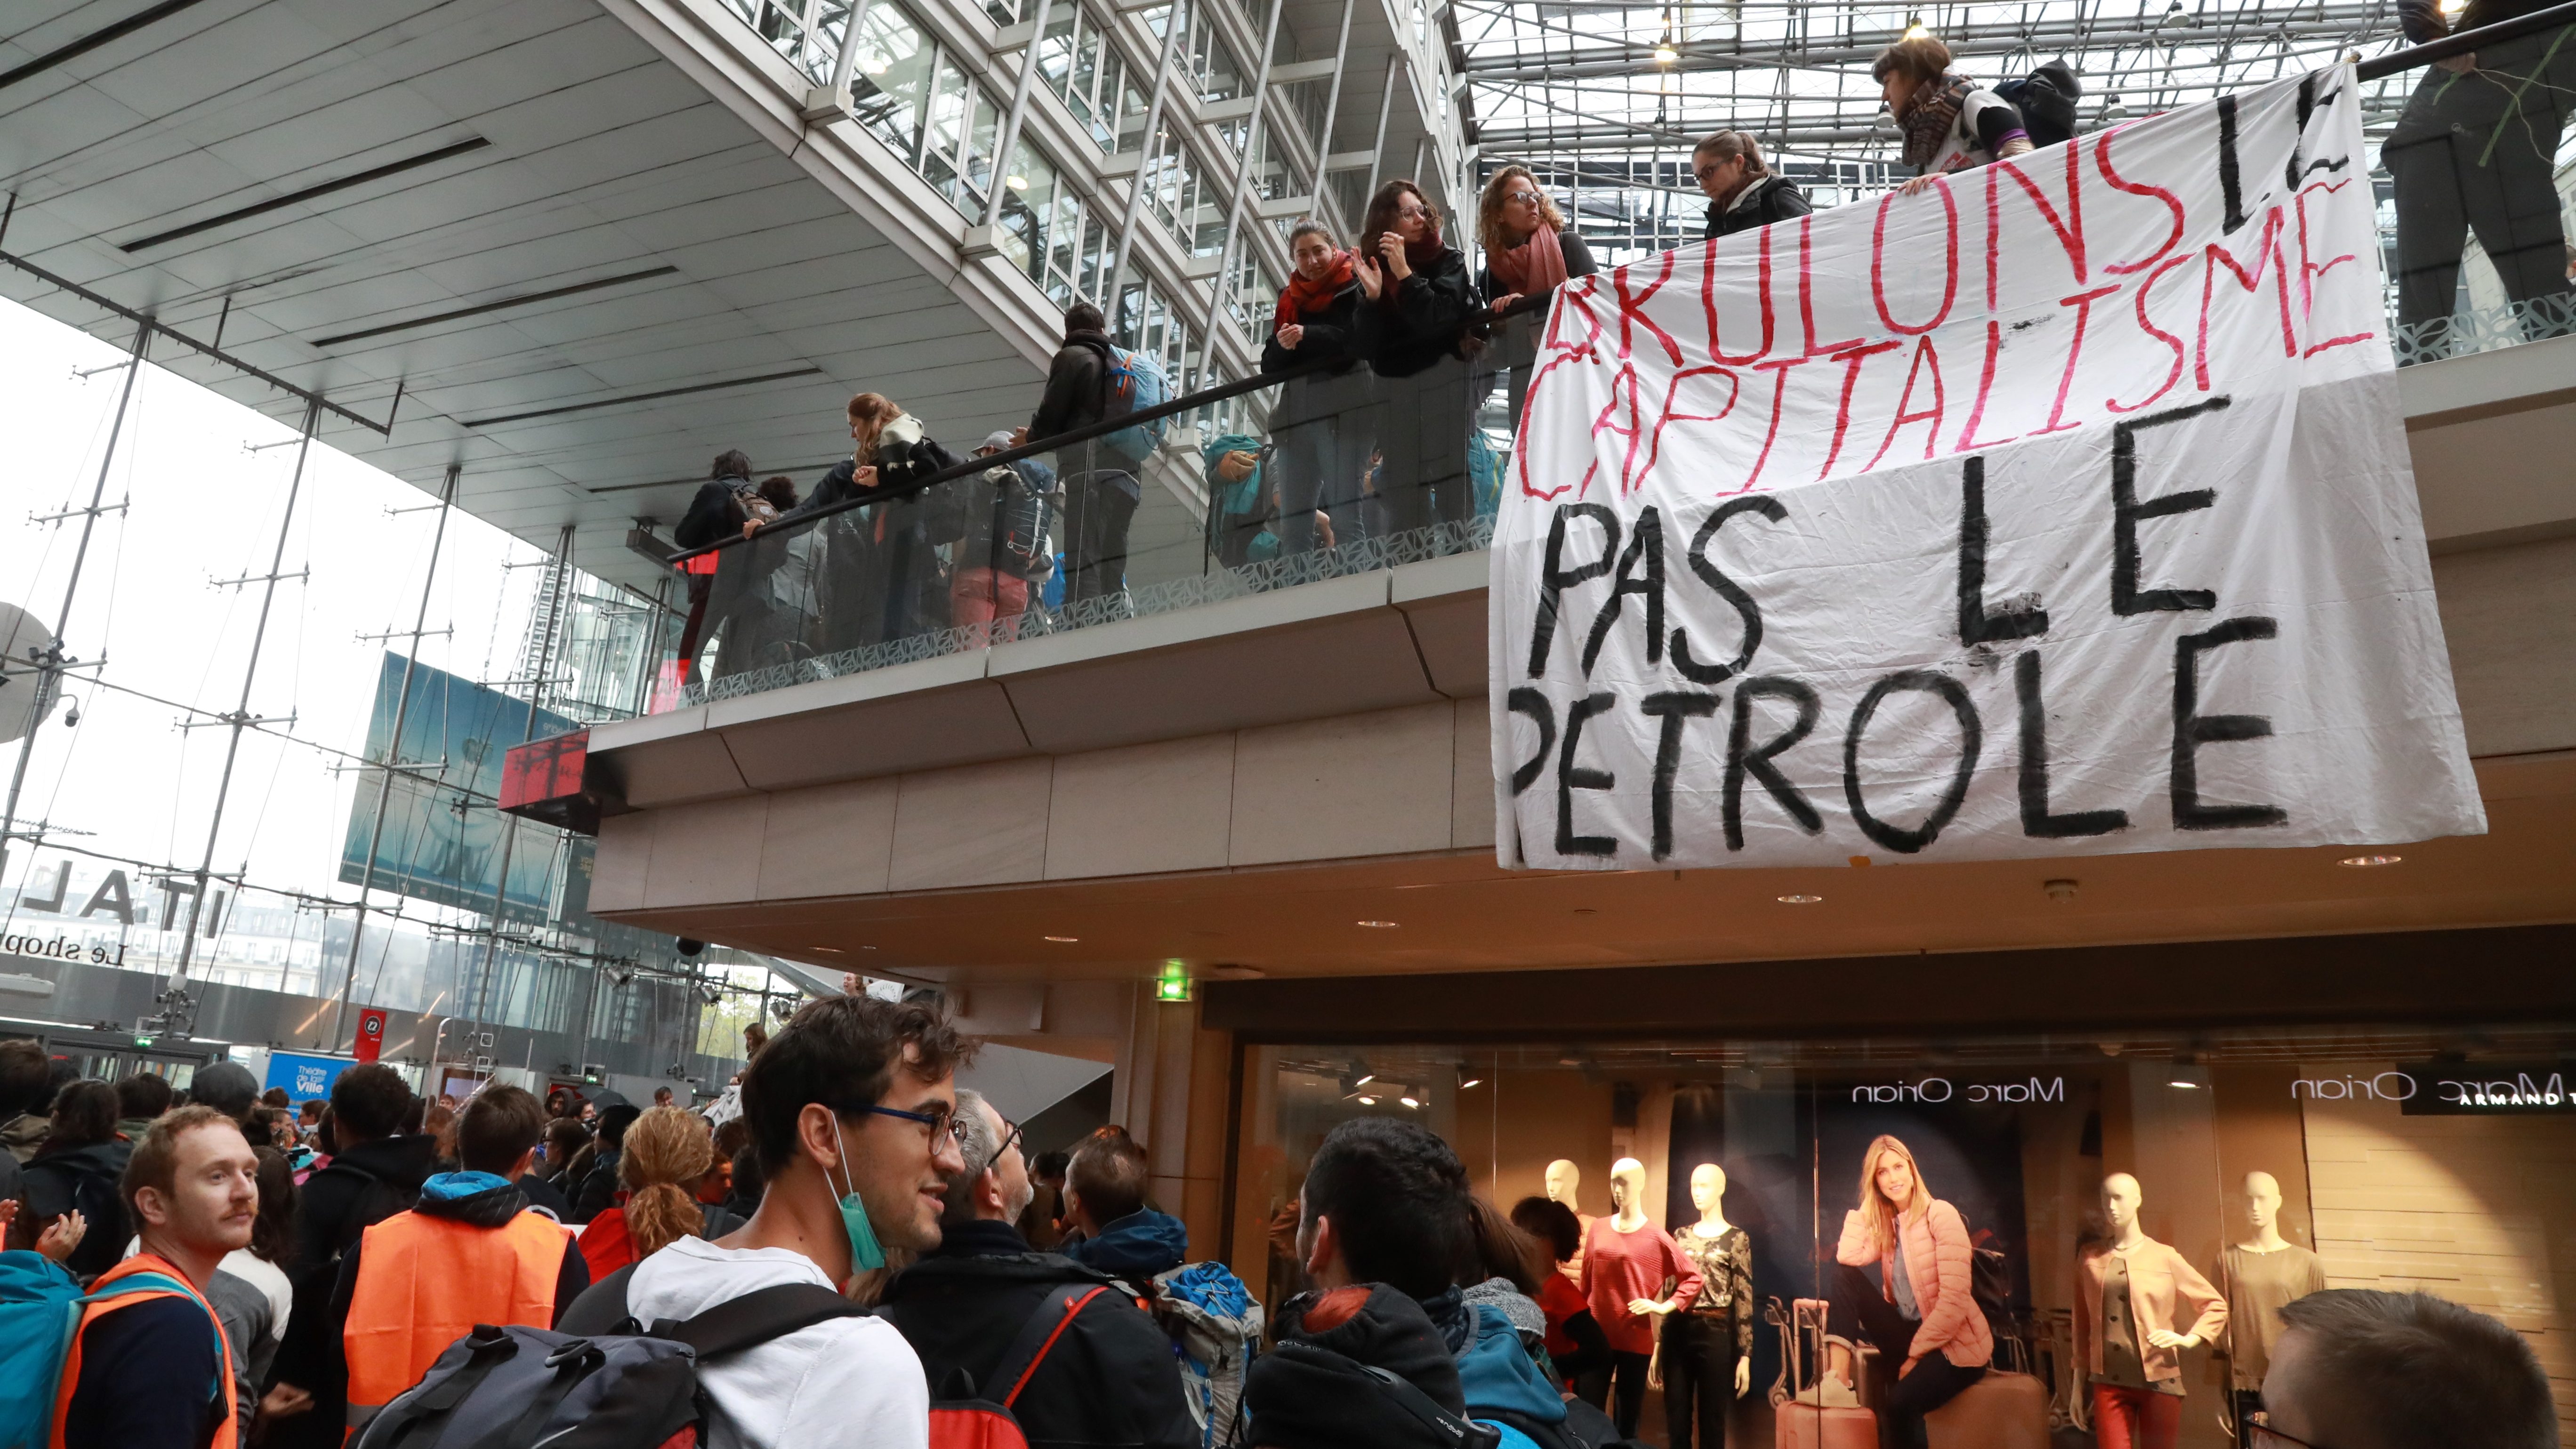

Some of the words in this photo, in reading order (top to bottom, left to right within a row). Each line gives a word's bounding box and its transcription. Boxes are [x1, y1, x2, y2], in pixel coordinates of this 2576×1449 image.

[1515, 177, 2374, 502] CAPITALISME
[1546, 111, 2185, 368] BRULONS
[1528, 494, 1787, 684] PAS
[1956, 394, 2232, 647] LE
[1509, 616, 2288, 864] PETROLE
[297, 1082, 324, 1093] Ville
[2460, 1093, 2560, 1105] ARMAND
